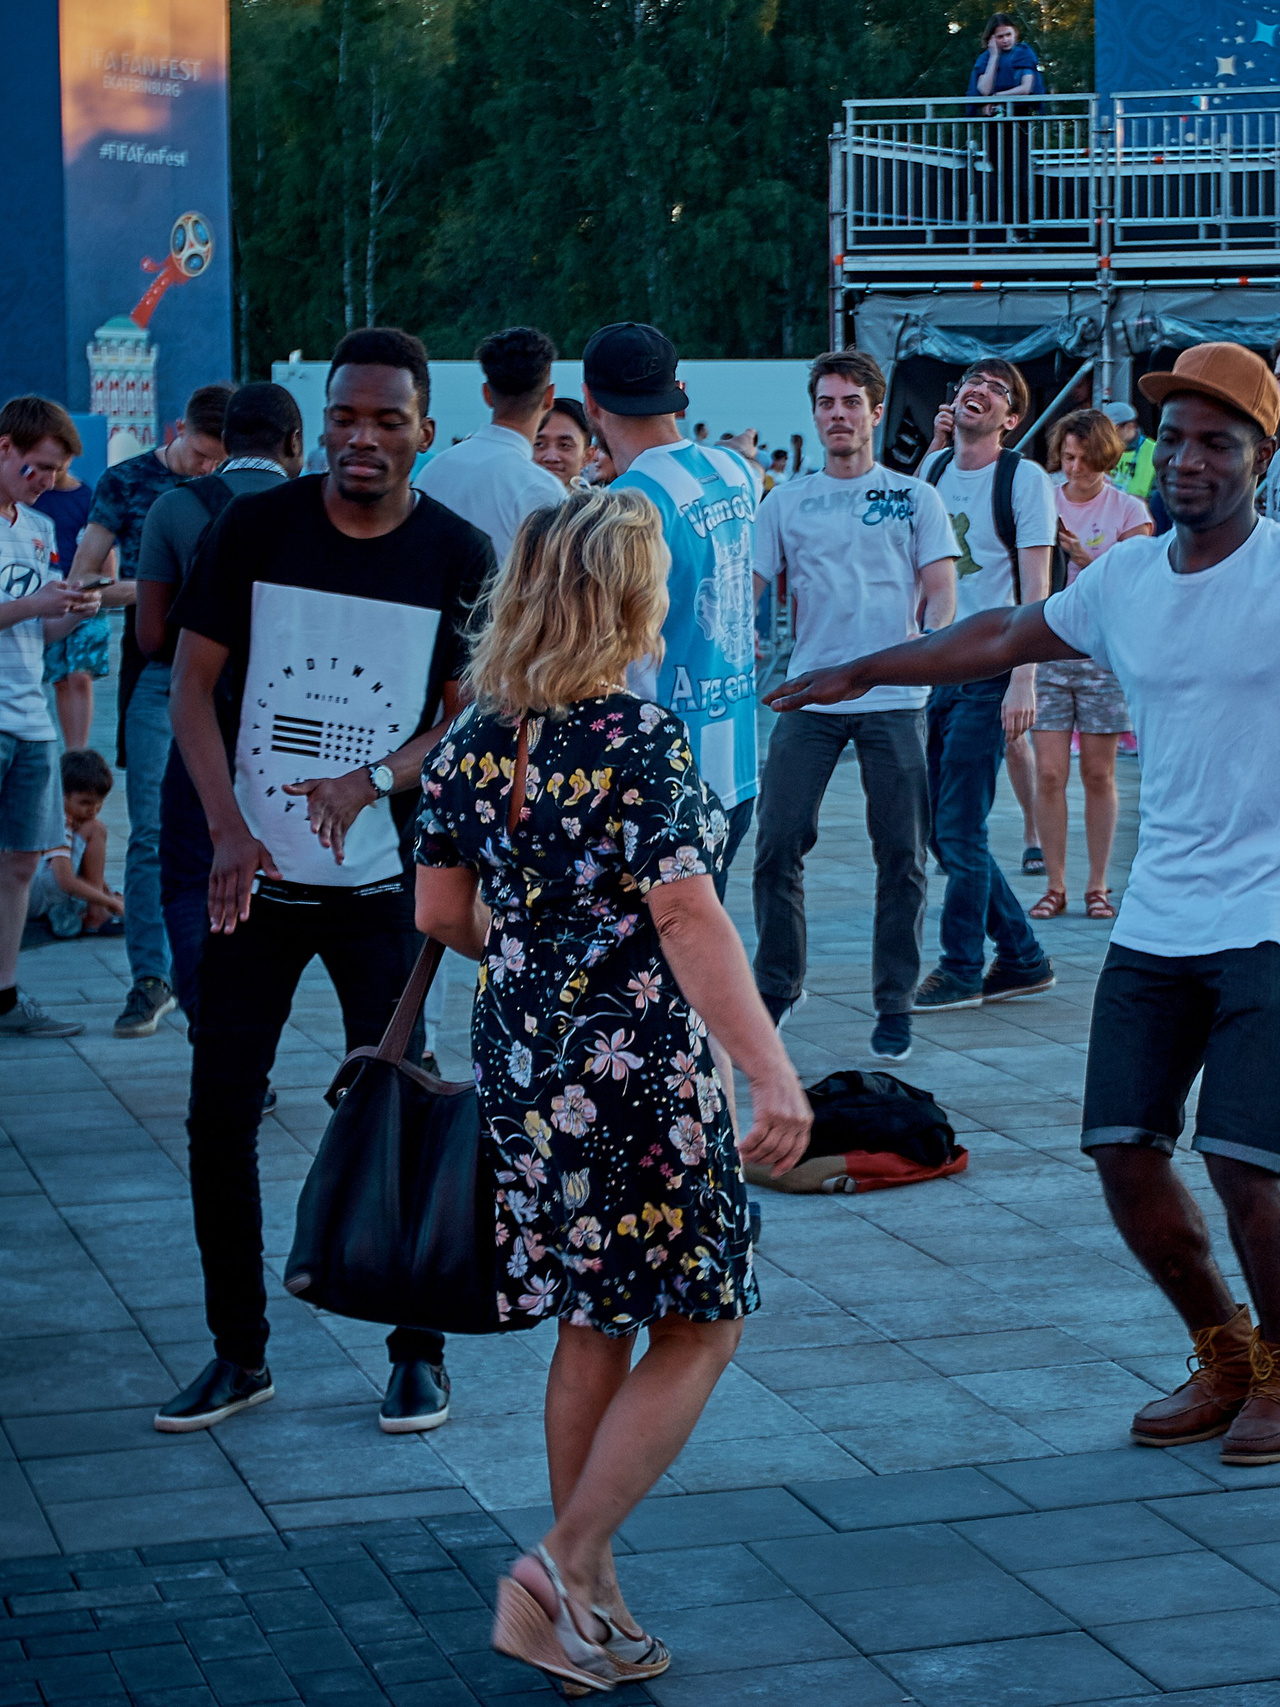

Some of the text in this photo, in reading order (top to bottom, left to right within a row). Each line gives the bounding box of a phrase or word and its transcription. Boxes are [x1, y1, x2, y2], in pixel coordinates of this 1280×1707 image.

[120, 52, 156, 76] FAN
[160, 58, 201, 82] FEST
[102, 75, 183, 98] EKATERINBURG
[99, 143, 189, 167] #FIFAFanFest
